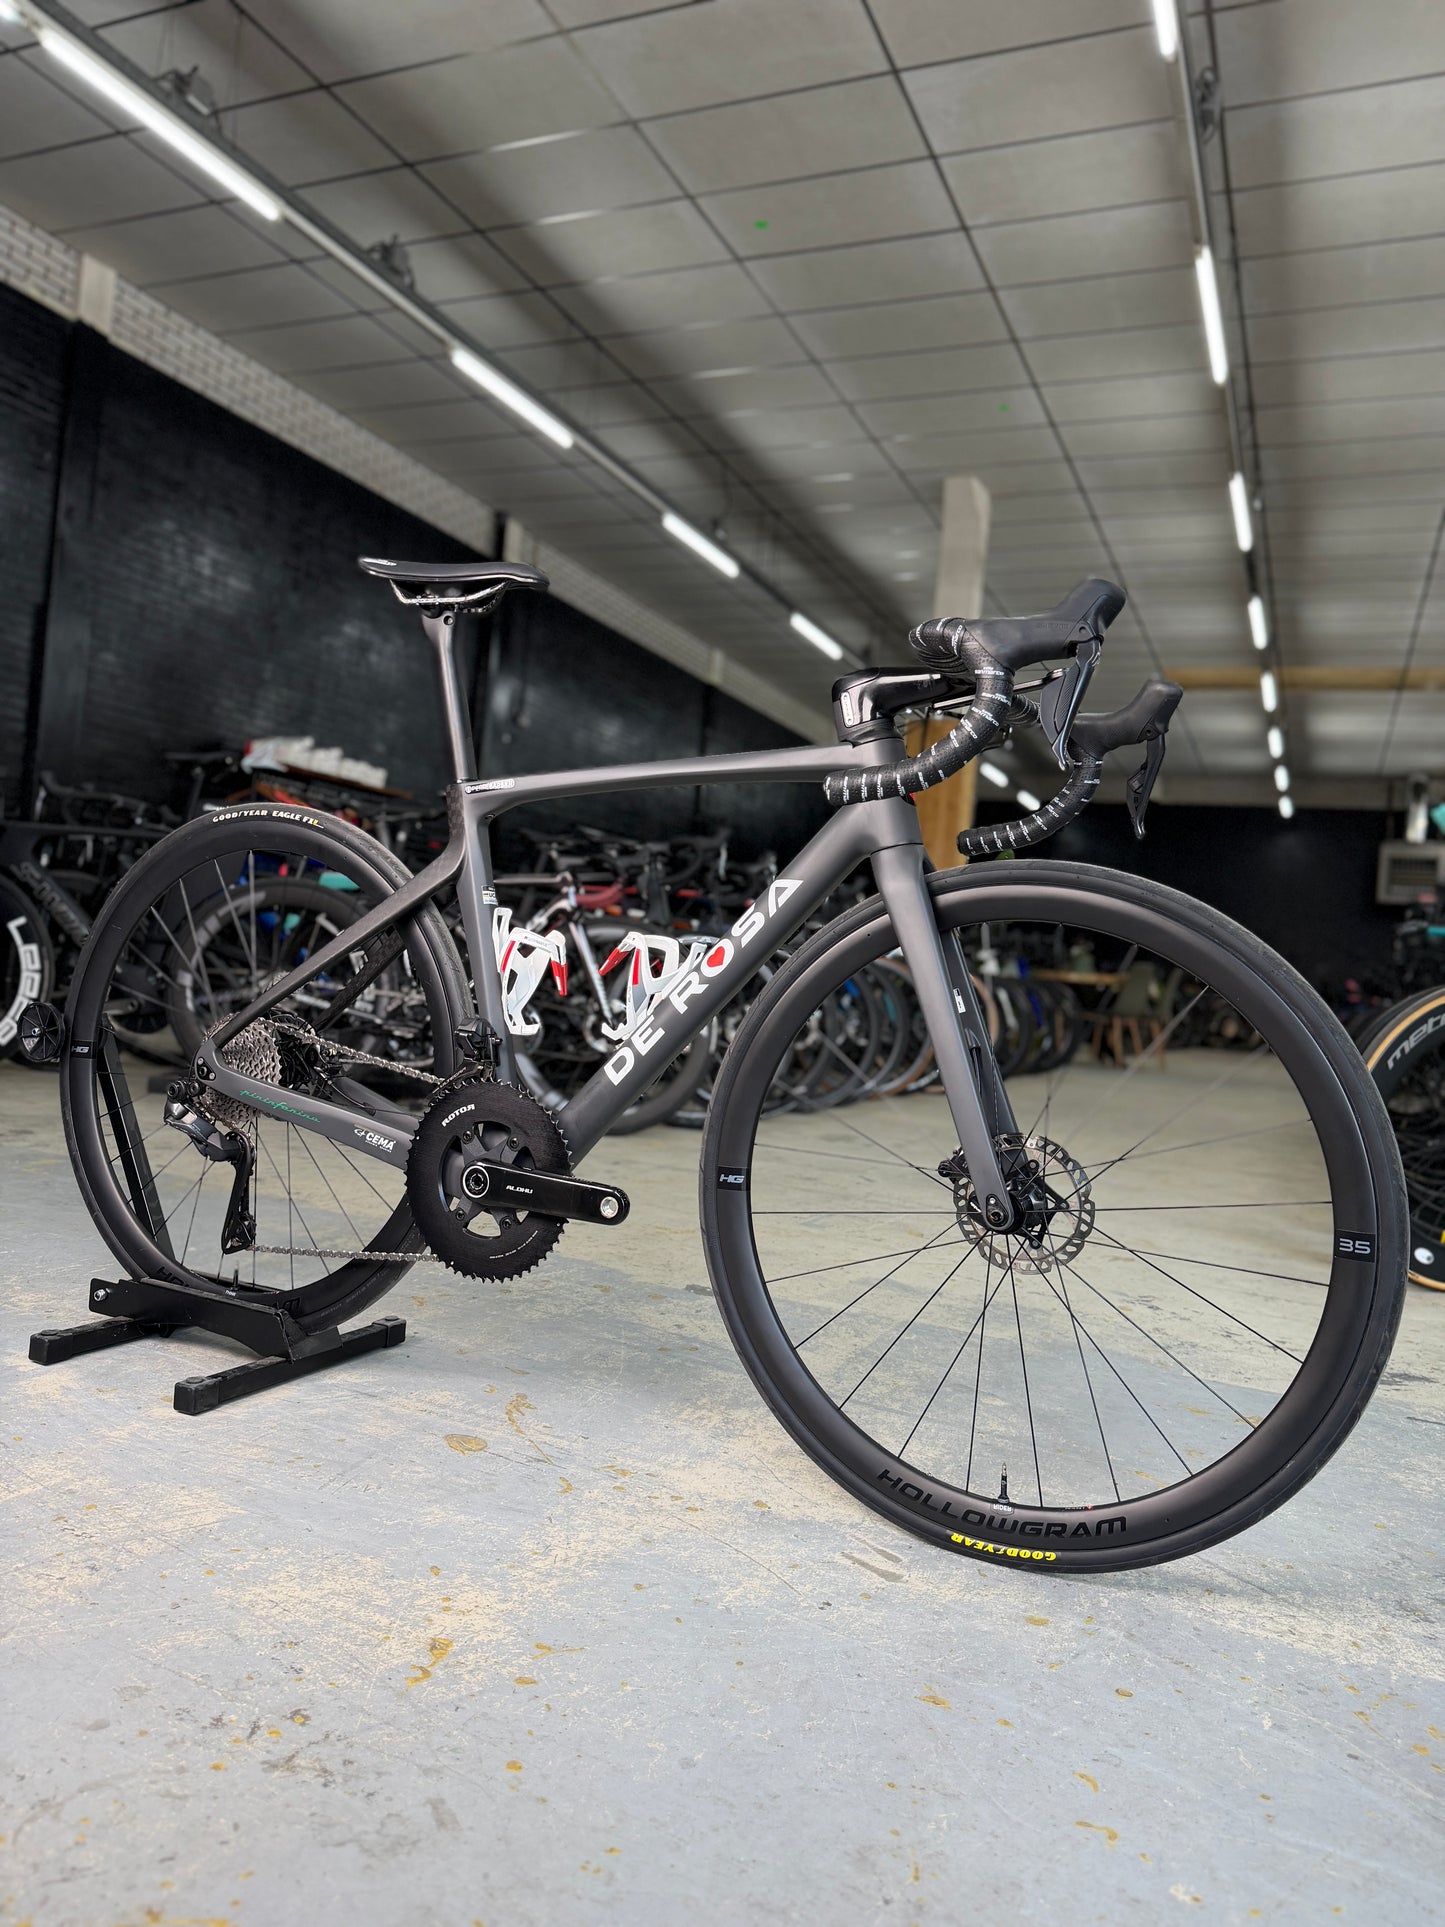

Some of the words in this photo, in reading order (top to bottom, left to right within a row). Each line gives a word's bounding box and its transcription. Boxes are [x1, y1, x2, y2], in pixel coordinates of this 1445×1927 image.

[271, 810, 302, 821] EAGLE
[604, 1015, 666, 1086] DE
[669, 879, 804, 1014] ROSA
[365, 1132, 396, 1151] CEMA
[719, 1173, 745, 1184] HG
[1339, 1237, 1371, 1255] 35
[876, 1469, 1127, 1538] HOLLOWGRAM
[950, 1532, 1057, 1561] GOODYEAR
